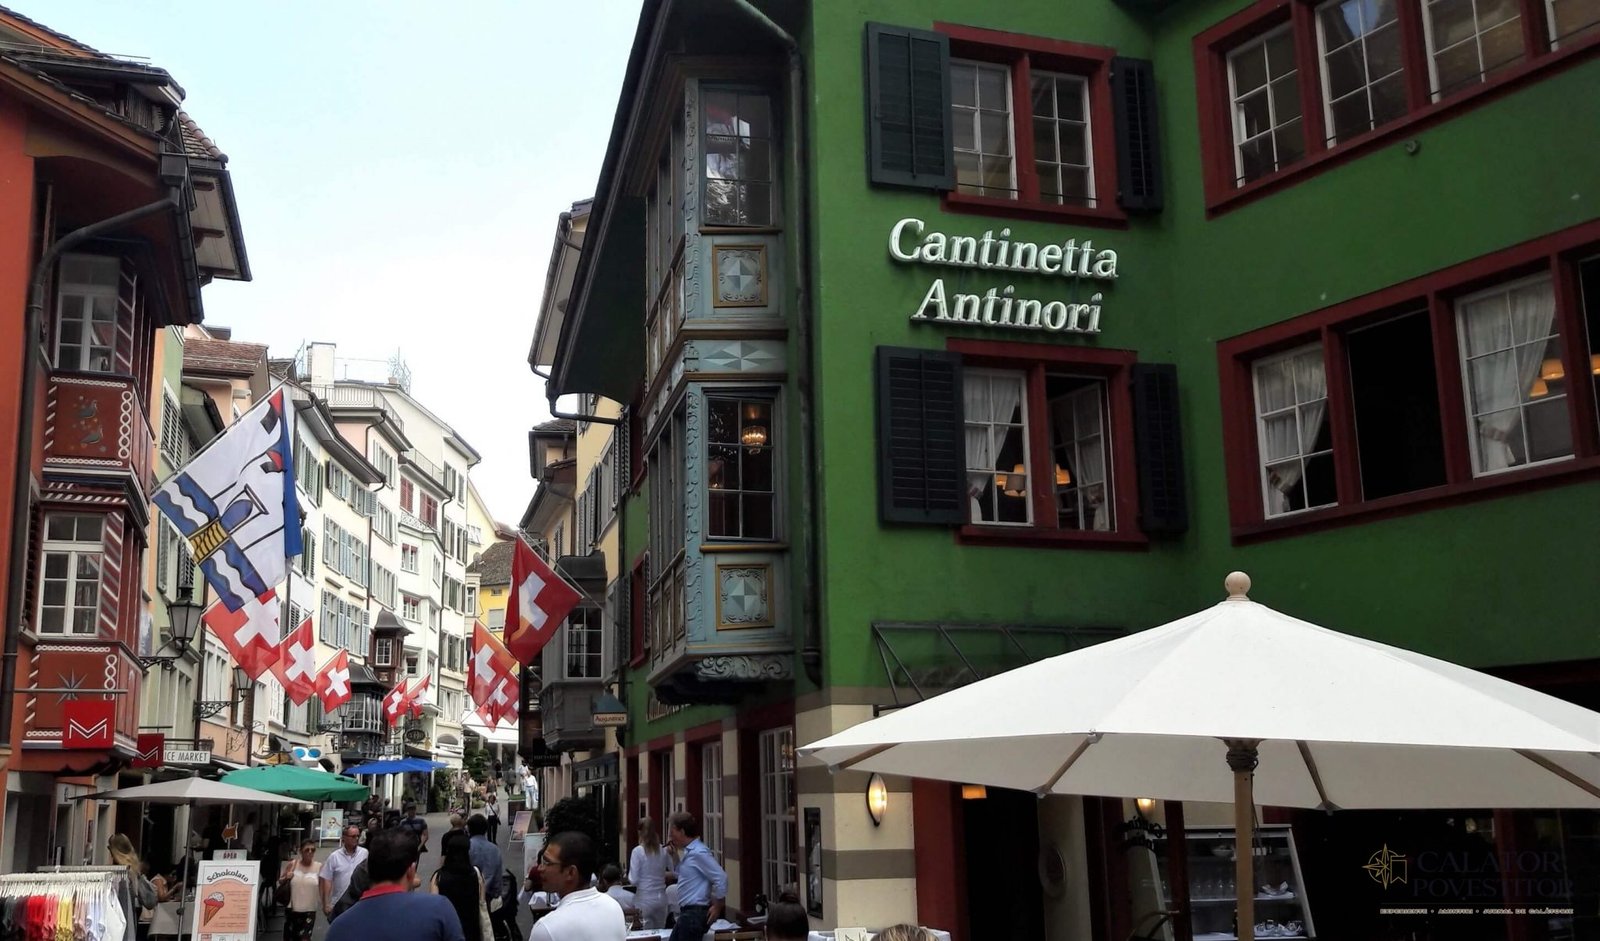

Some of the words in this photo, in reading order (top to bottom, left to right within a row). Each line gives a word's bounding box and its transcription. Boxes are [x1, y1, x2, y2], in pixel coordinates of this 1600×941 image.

[889, 218, 1119, 279] Cantinetta
[910, 279, 1102, 333] Antinori
[177, 752, 208, 762] MARKET
[206, 868, 249, 883] Schokolato
